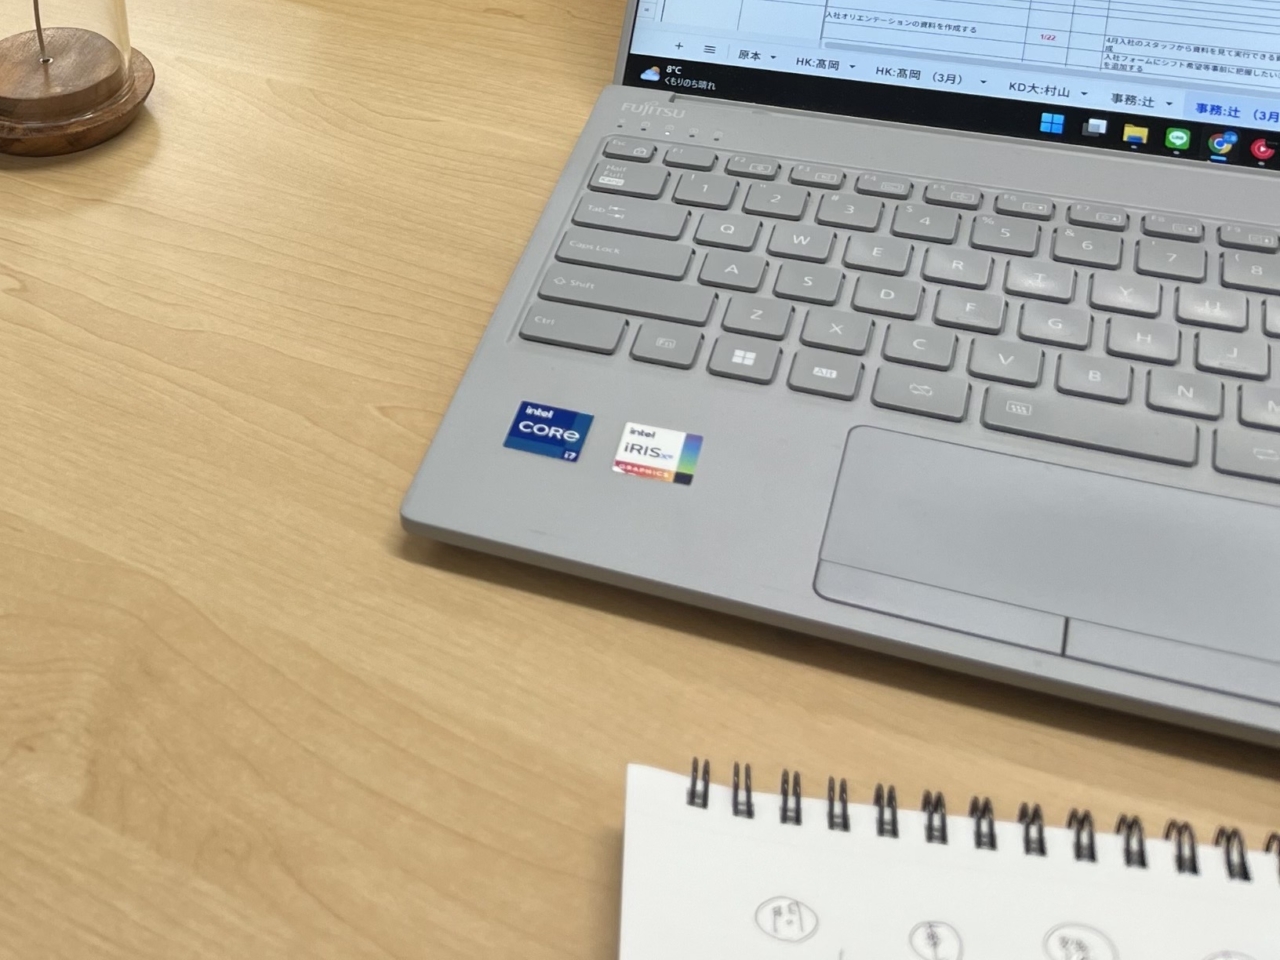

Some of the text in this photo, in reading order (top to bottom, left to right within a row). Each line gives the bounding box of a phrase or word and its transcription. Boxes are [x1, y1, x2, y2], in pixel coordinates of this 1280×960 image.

[825, 10, 977, 34] 入社オリエンテーションの資料を作成する
[1040, 33, 1056, 42] 1/22
[738, 49, 762, 62] 原本
[665, 65, 682, 75] 8°C
[664, 77, 716, 91] くもりのち晴れ
[620, 101, 687, 119] FUJITSU
[587, 204, 606, 213] Tab
[770, 194, 781, 204] 2
[844, 205, 855, 214] 3
[919, 216, 931, 226] 4
[1000, 228, 1010, 238] 5
[1082, 241, 1093, 250] 6
[1250, 265, 1263, 275] 8
[595, 244, 621, 255] Lock
[720, 223, 735, 235] Q
[792, 234, 811, 245] W
[872, 247, 884, 257] E
[952, 260, 964, 271] R
[570, 278, 595, 290] Shift
[724, 264, 1238, 359] A S D F G H J
[534, 315, 556, 325] Ctrl
[750, 309, 1194, 398] Z X C V B N
[814, 367, 836, 378] Alt
[525, 405, 554, 419] intel
[629, 427, 656, 439] intel
[564, 450, 578, 460] i7
[618, 462, 671, 479] GRAPHICS
